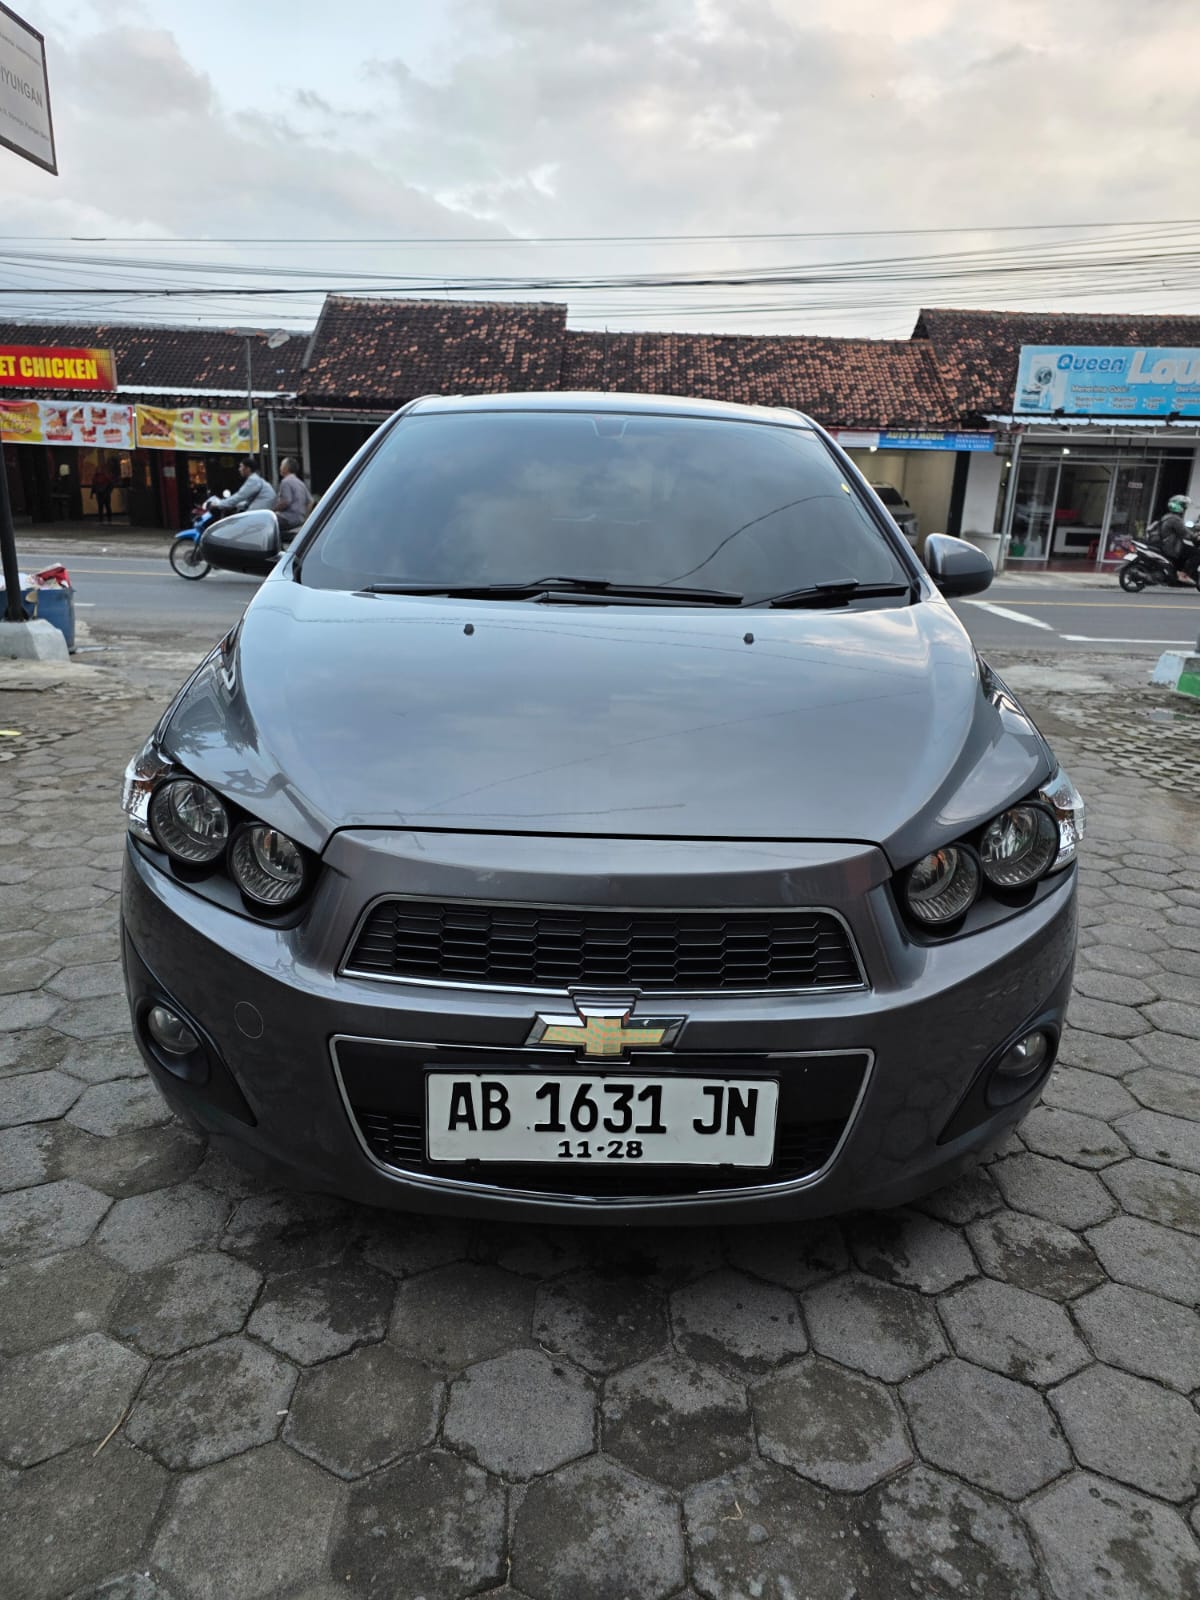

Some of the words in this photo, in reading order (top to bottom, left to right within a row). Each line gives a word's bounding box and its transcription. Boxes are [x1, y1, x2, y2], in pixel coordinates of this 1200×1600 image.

[19, 356, 98, 380] CHICKEN
[1056, 353, 1126, 373] Queen
[447, 1081, 511, 1131] AB
[534, 1082, 667, 1134] 1631
[692, 1085, 759, 1137] JN
